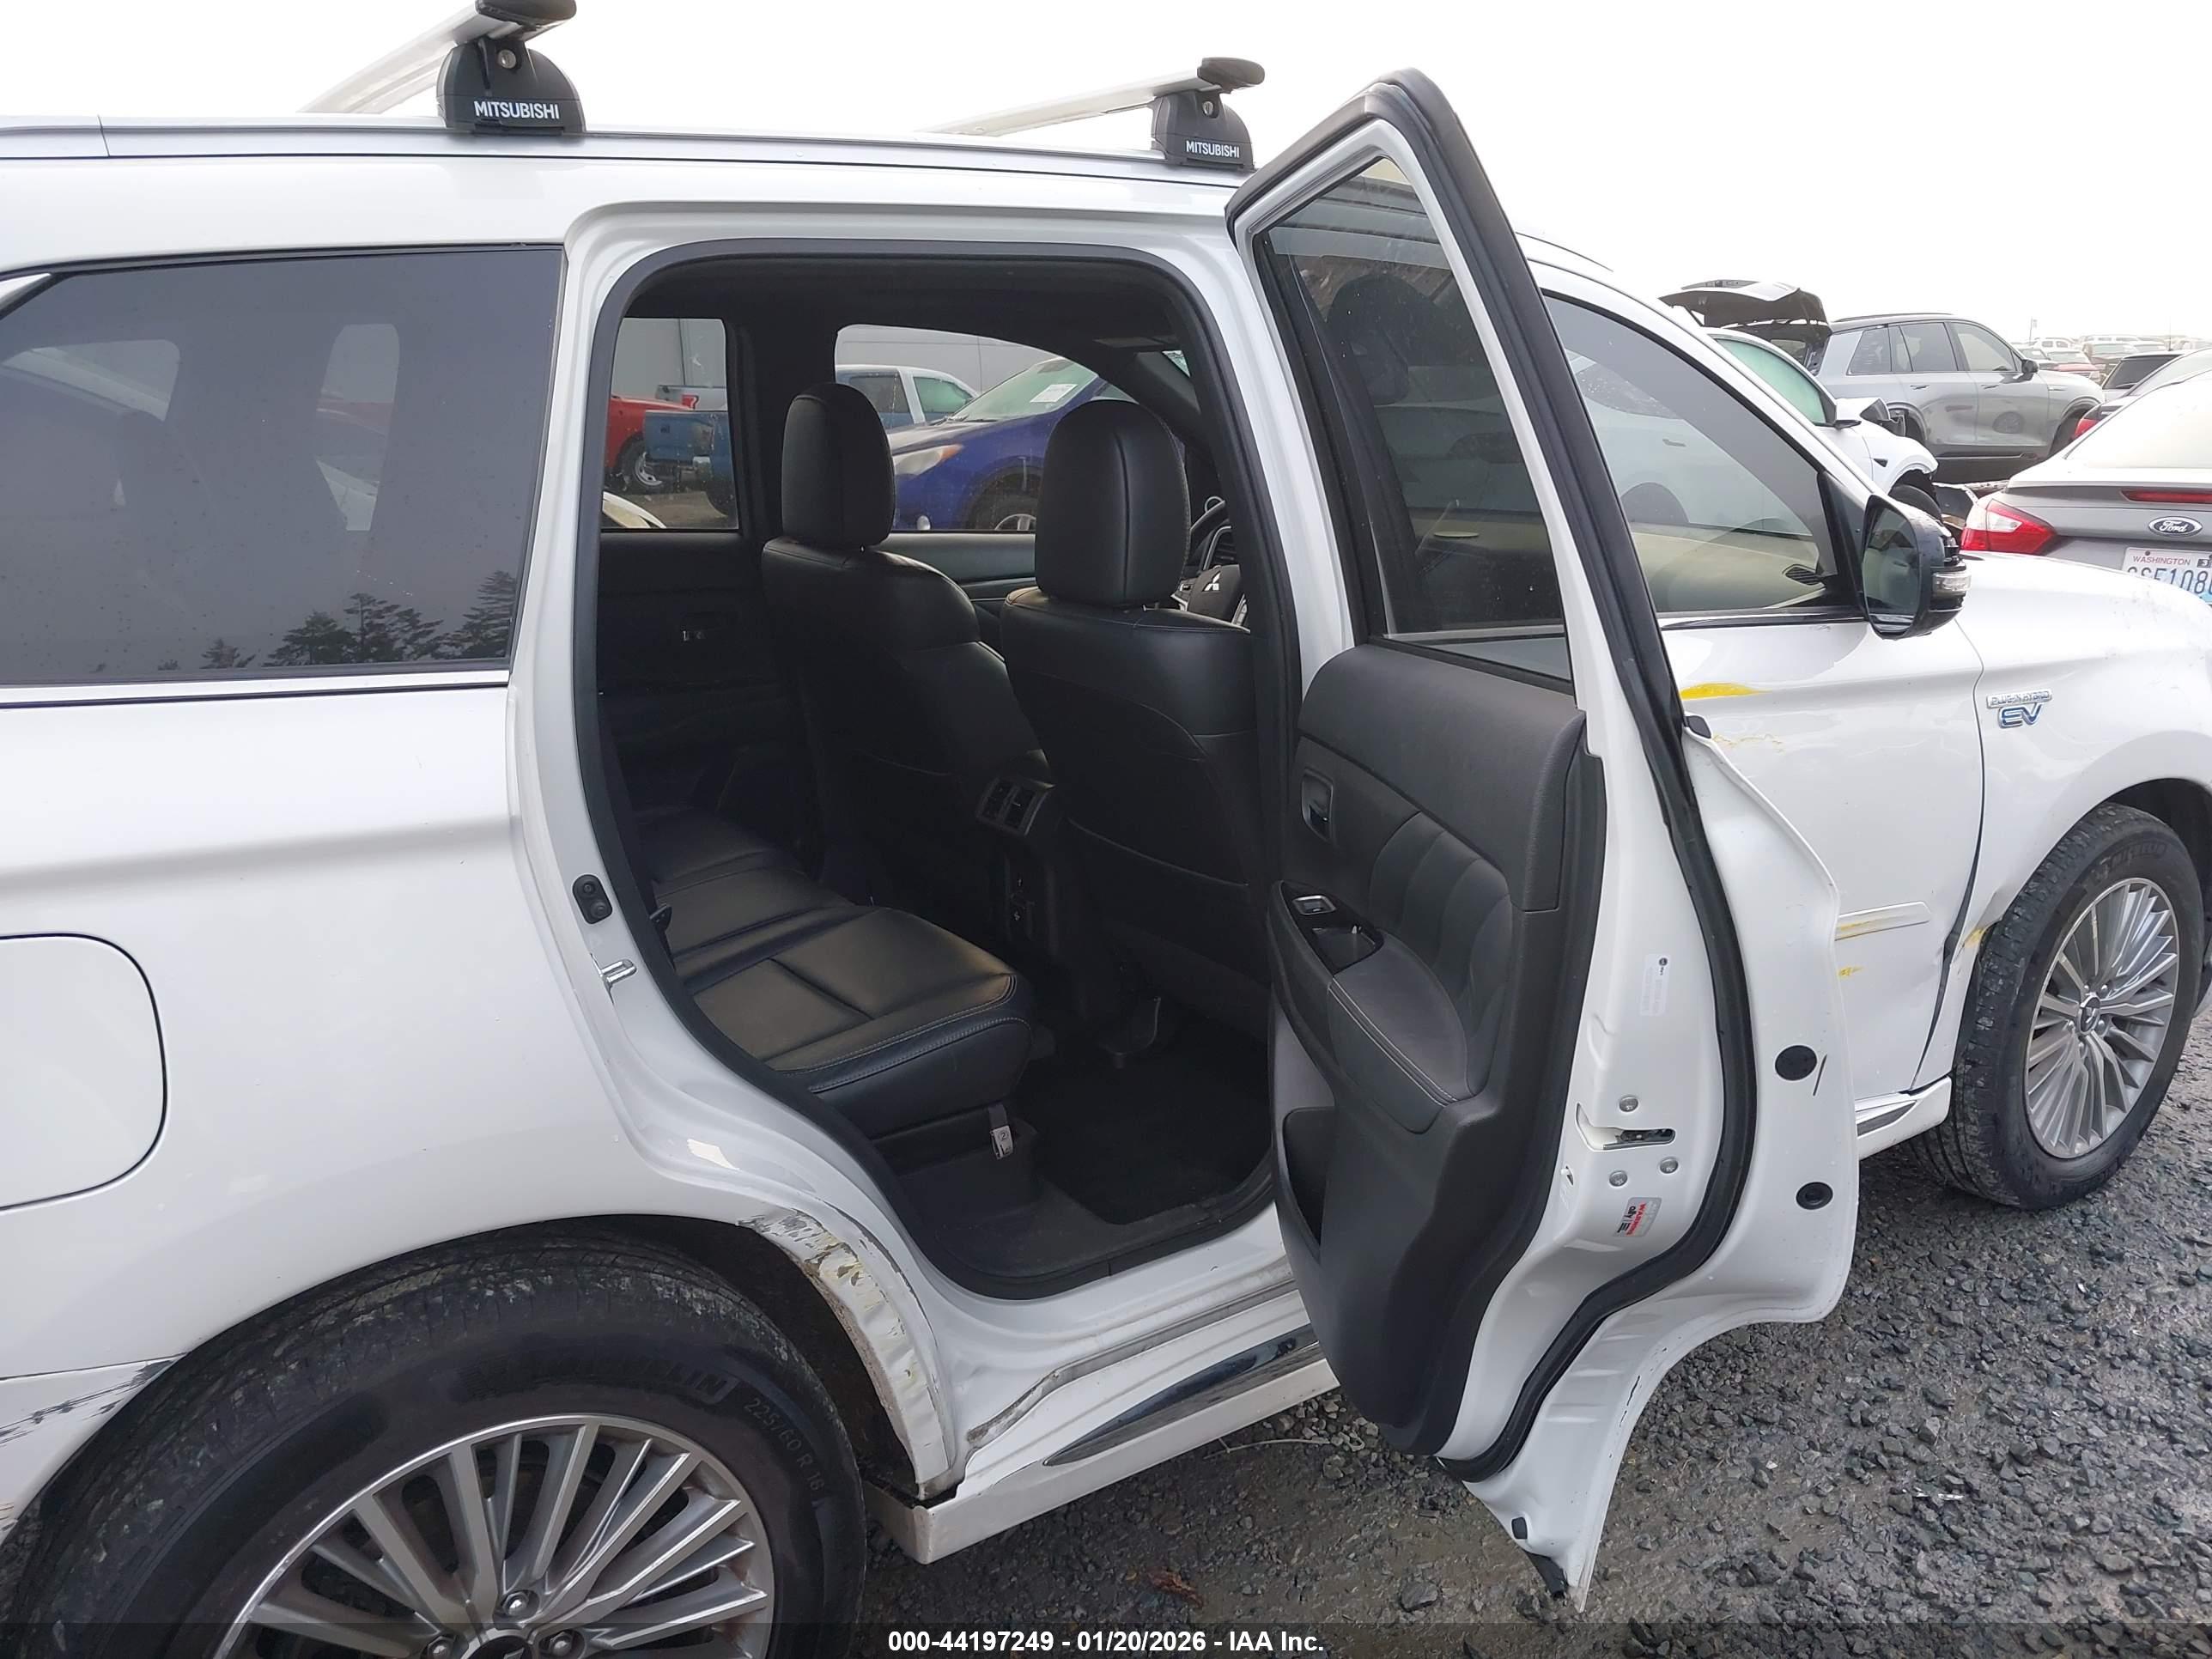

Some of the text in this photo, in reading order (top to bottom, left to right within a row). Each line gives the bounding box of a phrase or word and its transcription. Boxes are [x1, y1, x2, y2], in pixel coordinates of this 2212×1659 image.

[474, 100, 560, 119] MITSUBISHI
[1186, 140, 1240, 158] MITSUBISHI
[2159, 520, 2187, 533] Ford
[2132, 555, 2191, 566] WASHINGTON
[2000, 704, 2042, 728] EV
